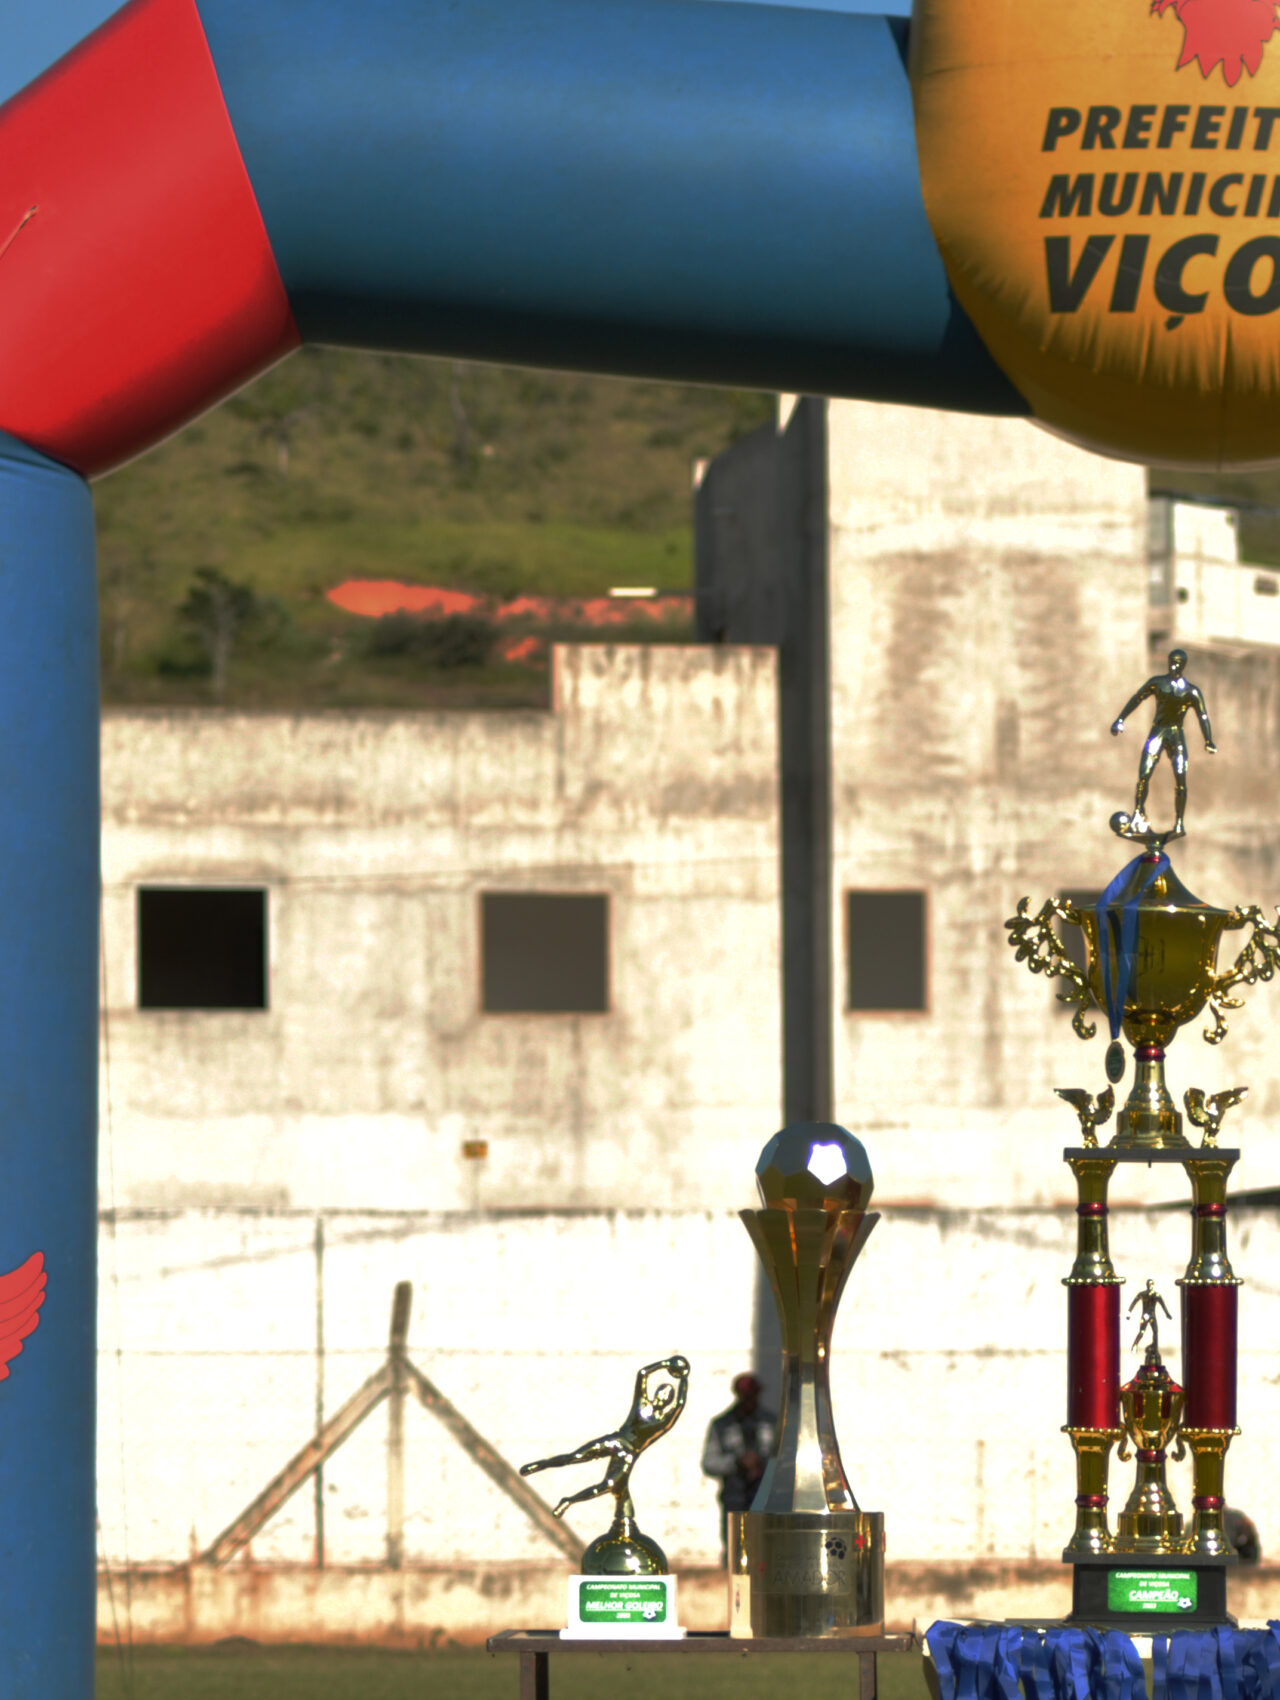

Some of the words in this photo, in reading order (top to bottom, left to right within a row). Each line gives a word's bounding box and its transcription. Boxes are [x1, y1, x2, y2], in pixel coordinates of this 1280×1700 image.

[1129, 1588, 1179, 1601] CAMPEÃO
[586, 1601, 624, 1611] MELHOR
[625, 1601, 664, 1611] GOLEIRO
